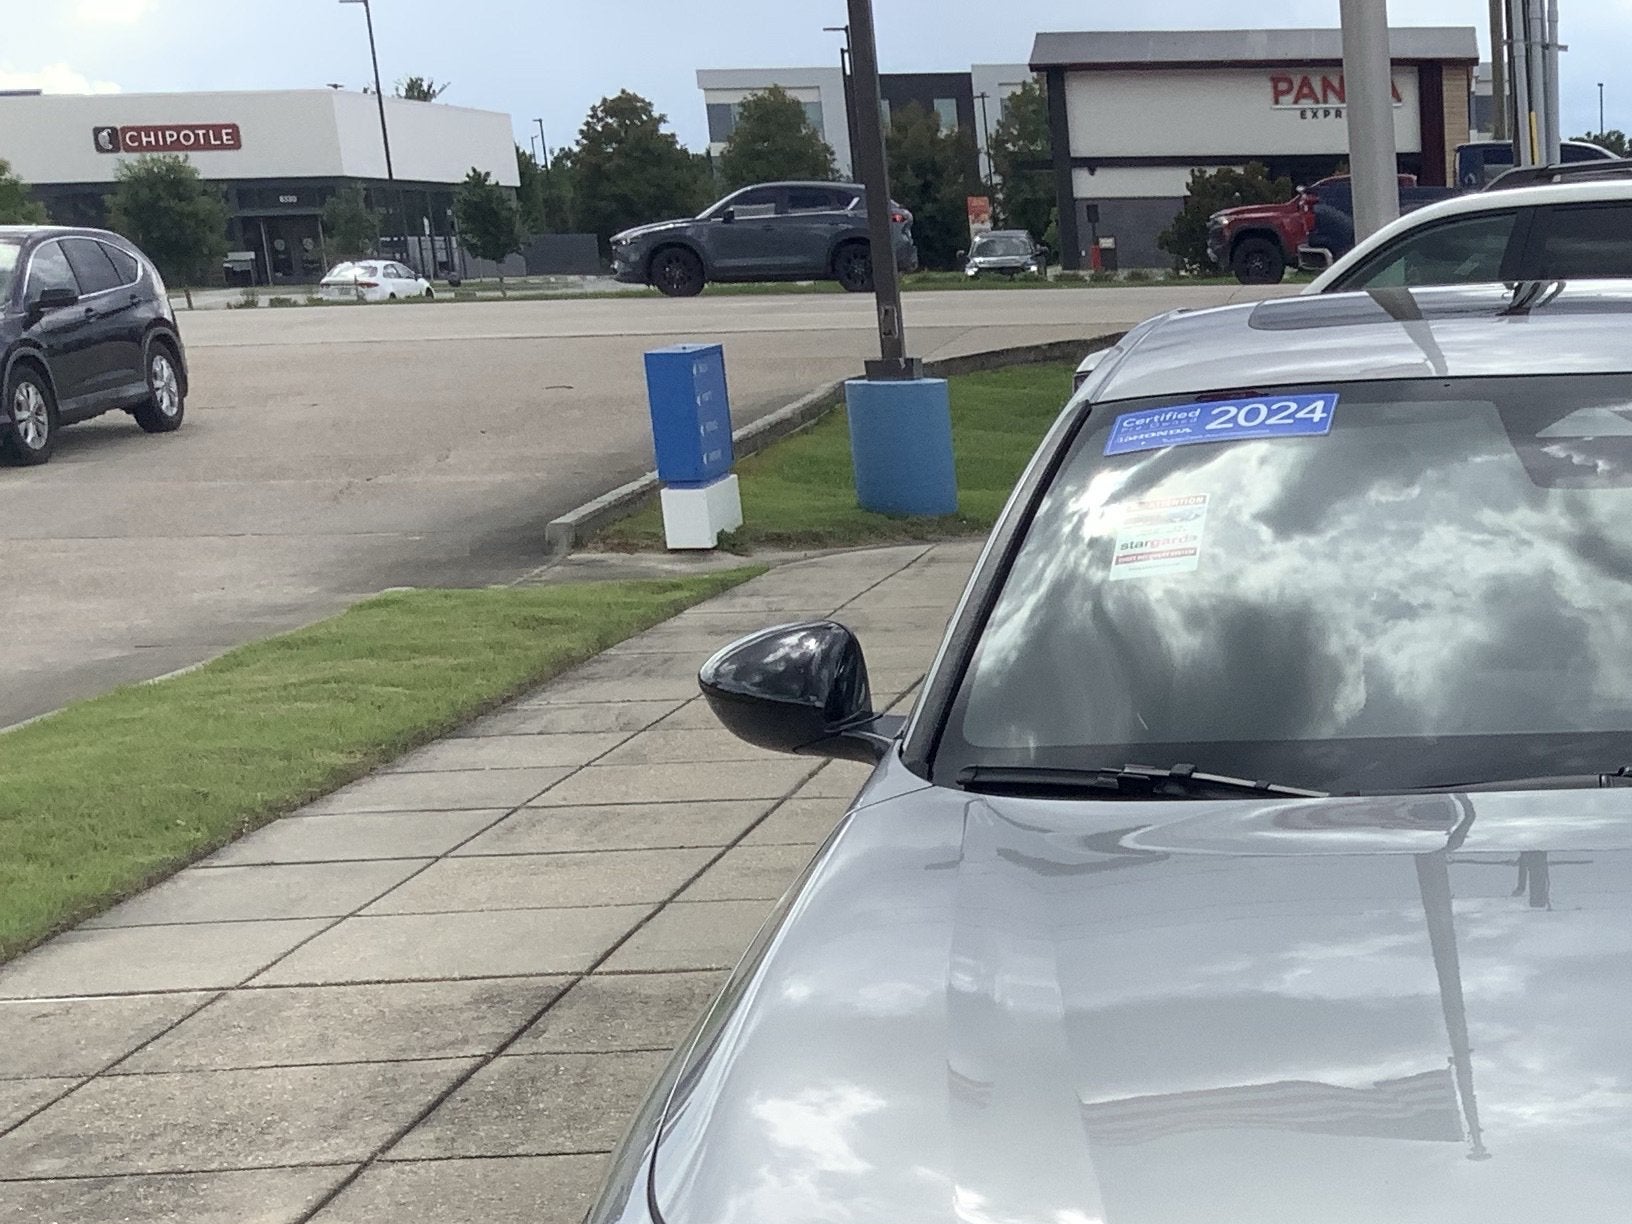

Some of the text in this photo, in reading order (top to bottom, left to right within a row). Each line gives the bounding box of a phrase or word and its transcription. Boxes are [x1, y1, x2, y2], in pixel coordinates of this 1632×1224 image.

[1270, 74, 1402, 105] PAN
[125, 129, 235, 147] CHIPOTLE
[1122, 408, 1201, 428] Certified
[1205, 400, 1328, 430] 2024
